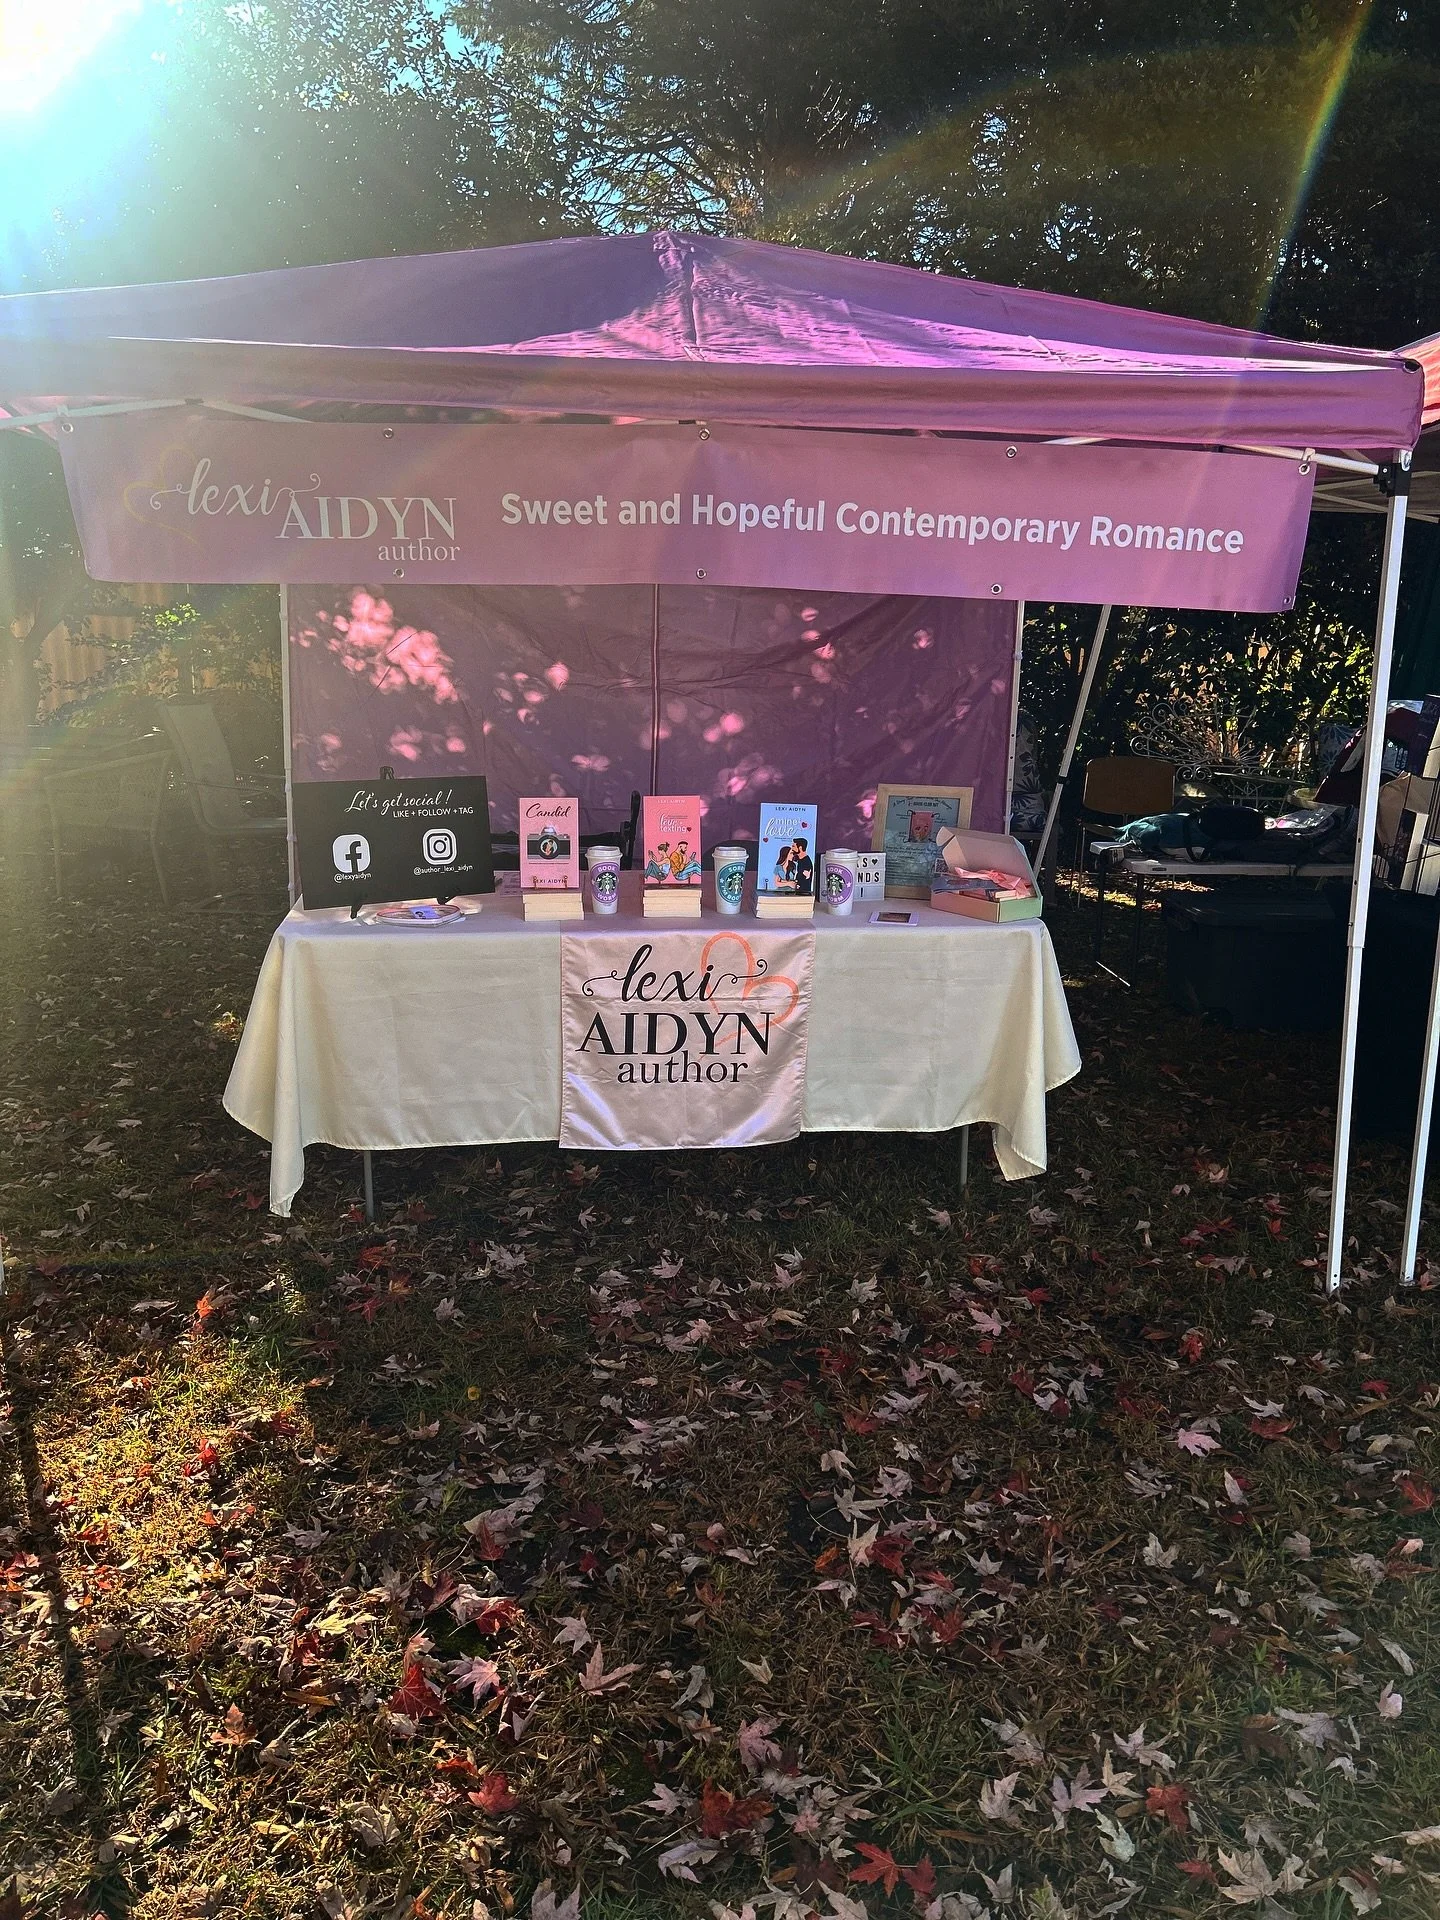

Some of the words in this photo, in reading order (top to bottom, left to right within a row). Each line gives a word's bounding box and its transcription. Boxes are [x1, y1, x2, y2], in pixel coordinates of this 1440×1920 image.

[150, 457, 321, 516] lexi
[275, 496, 457, 541] AIDYN
[501, 492, 608, 526] Sweet
[618, 493, 681, 525] and
[692, 494, 826, 533] Hopeful
[836, 502, 1081, 550] Contemporary
[1090, 515, 1245, 554] Romance
[378, 539, 461, 562] author
[344, 790, 379, 813] Let's
[380, 792, 402, 816] get
[393, 808, 410, 818] LIKE
[418, 808, 451, 817] FOLLOW
[459, 806, 474, 815] TAG
[525, 802, 572, 819] Candid
[660, 825, 687, 834] texting
[764, 817, 798, 837] love
[413, 864, 474, 876] @author_lexi_aidyn
[597, 865, 617, 873] BOOK
[597, 892, 617, 901] WORM
[582, 943, 769, 1003] lexi
[575, 1011, 776, 1056] AIDYN
[617, 1050, 749, 1084] author
